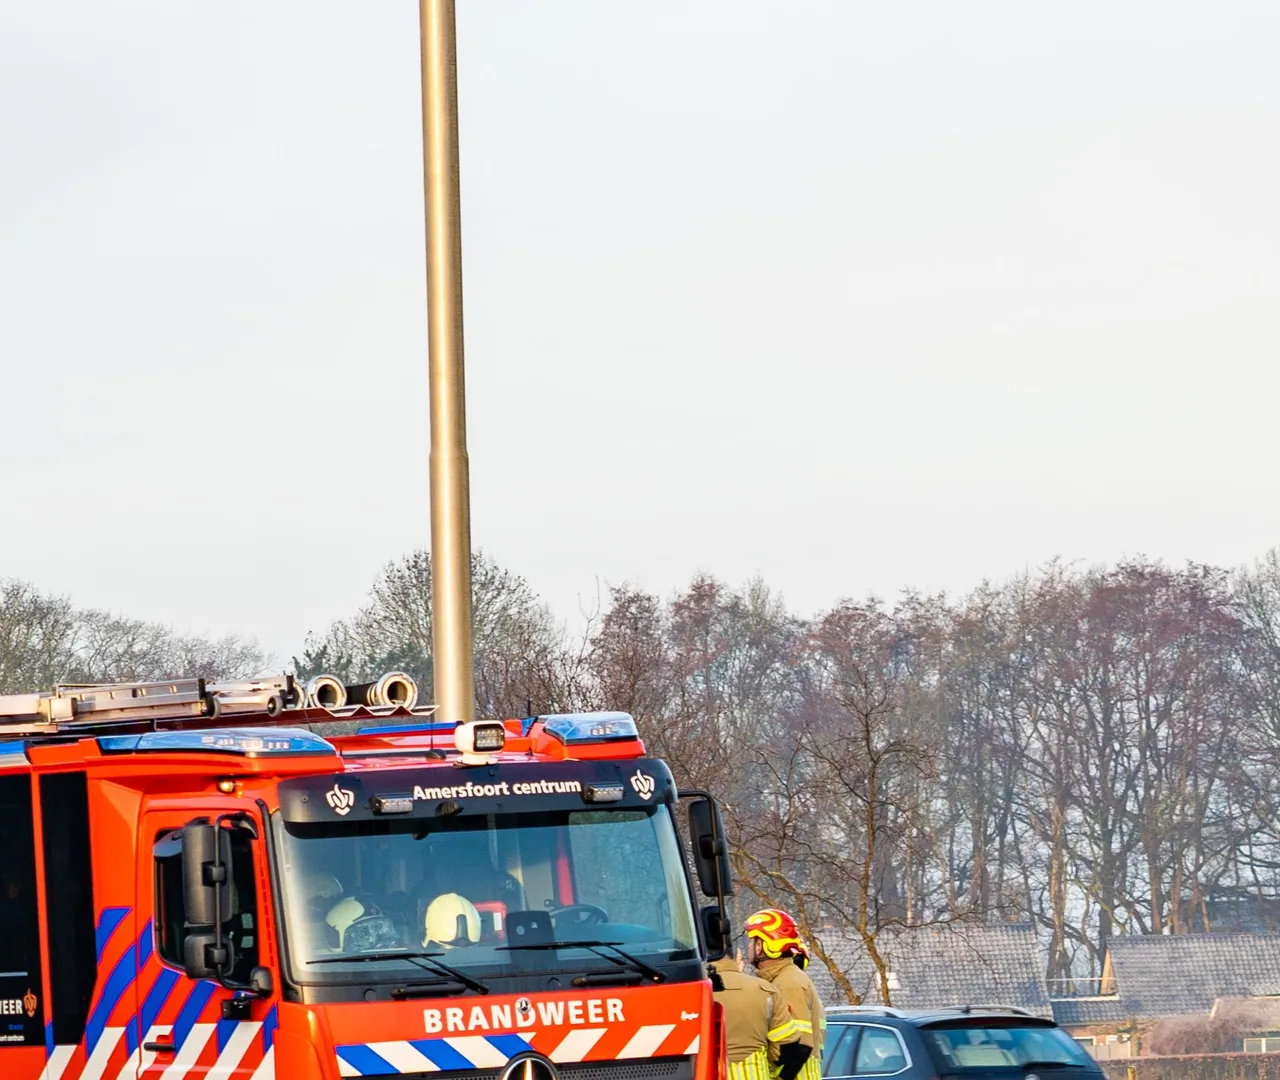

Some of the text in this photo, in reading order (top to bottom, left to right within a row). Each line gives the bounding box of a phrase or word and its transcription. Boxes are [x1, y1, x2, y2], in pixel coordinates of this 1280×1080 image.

[413, 780, 582, 800] Amersfoort centrum
[423, 997, 626, 1034] BRANDWEER
